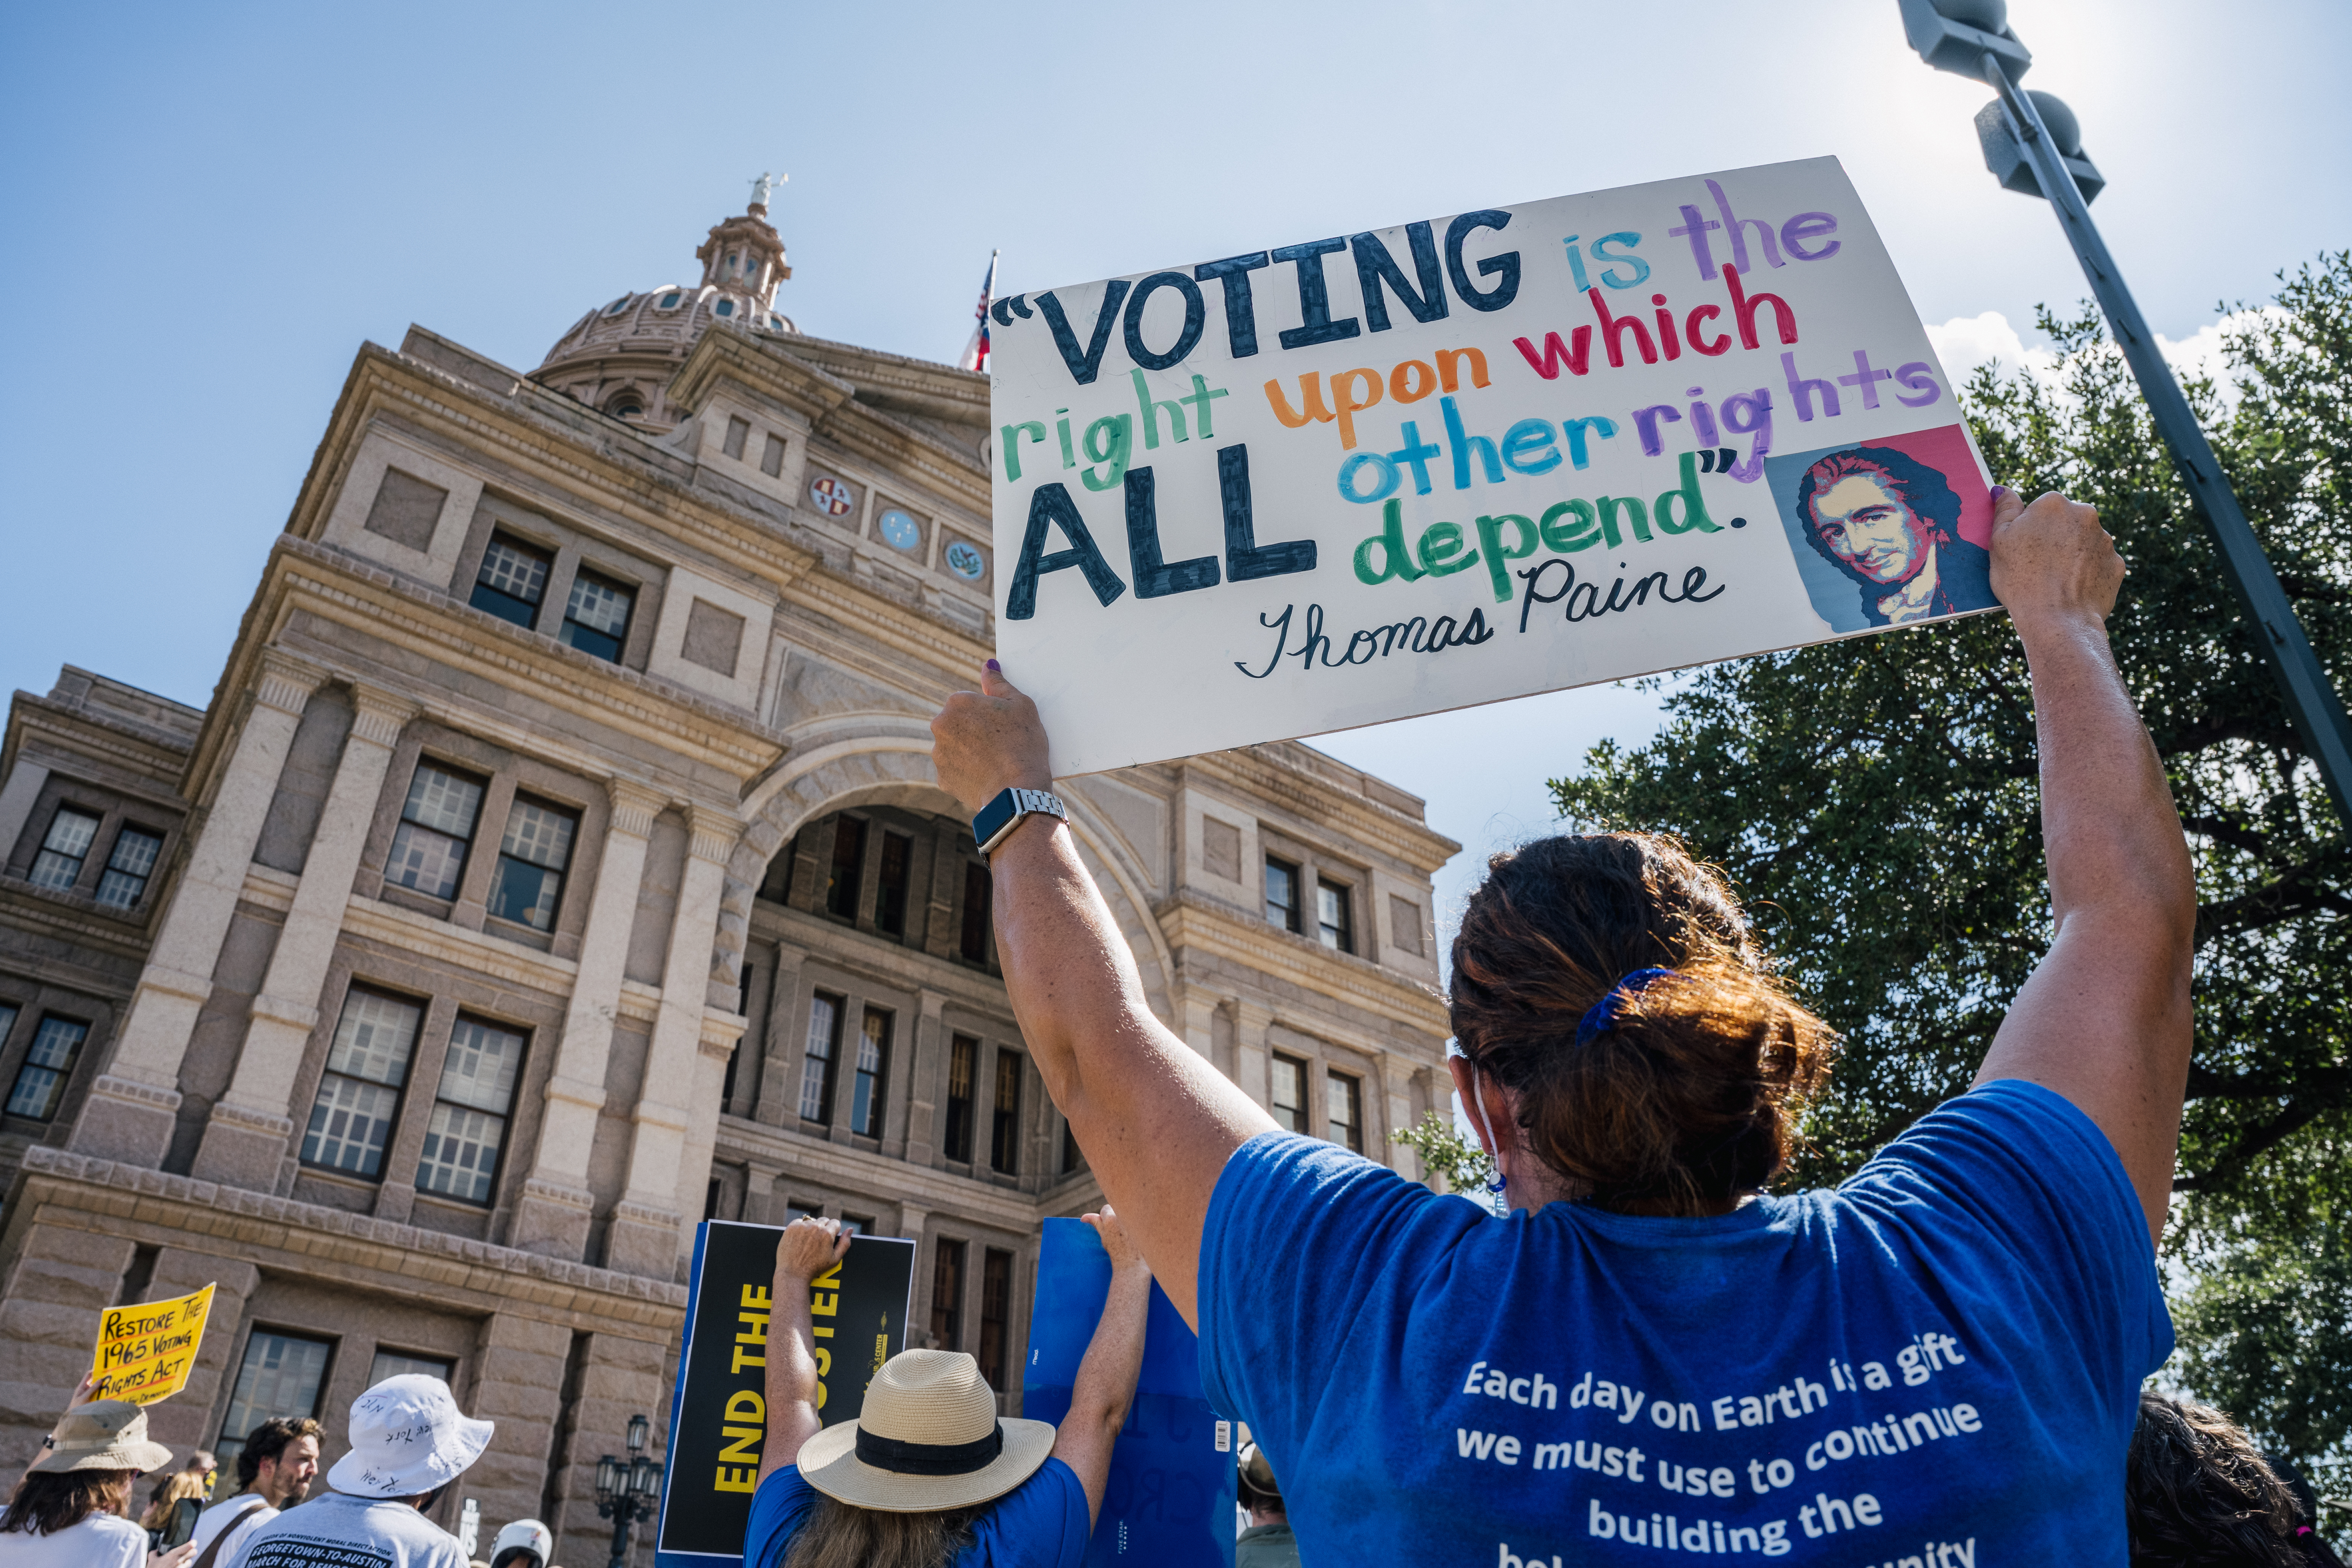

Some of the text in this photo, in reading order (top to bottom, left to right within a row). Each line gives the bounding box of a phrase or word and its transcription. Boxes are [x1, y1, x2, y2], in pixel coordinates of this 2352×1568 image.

[990, 178, 1842, 385] “VOTING is the
[1000, 263, 1799, 492] right upon which
[1005, 349, 1941, 621] ALL other rights
[1234, 558, 1725, 678] Thomas Paine
[104, 1296, 203, 1341] RESTORE THE
[104, 1330, 191, 1368] 1965 VOTING
[875, 1334, 883, 1357] CENTER
[97, 1358, 185, 1400] RIGHTS ACT
[714, 1284, 772, 1494] END THE
[1463, 1332, 1965, 1432] Each day on Earth is a gift
[361, 1399, 384, 1413] NYC
[385, 1428, 413, 1445] York
[1457, 1402, 1983, 1498] we must use to continue
[288, 1533, 326, 1543] NONVIOLENT
[347, 1541, 368, 1550] DIRECT
[368, 1545, 392, 1557] ACTION
[1589, 1498, 1792, 1556] building
[1798, 1492, 1883, 1538] the
[246, 1556, 283, 1568] MARCH
[281, 1557, 306, 1568] FOR
[251, 1543, 387, 1568] GEORGETOWN-TO-AUSTIN
